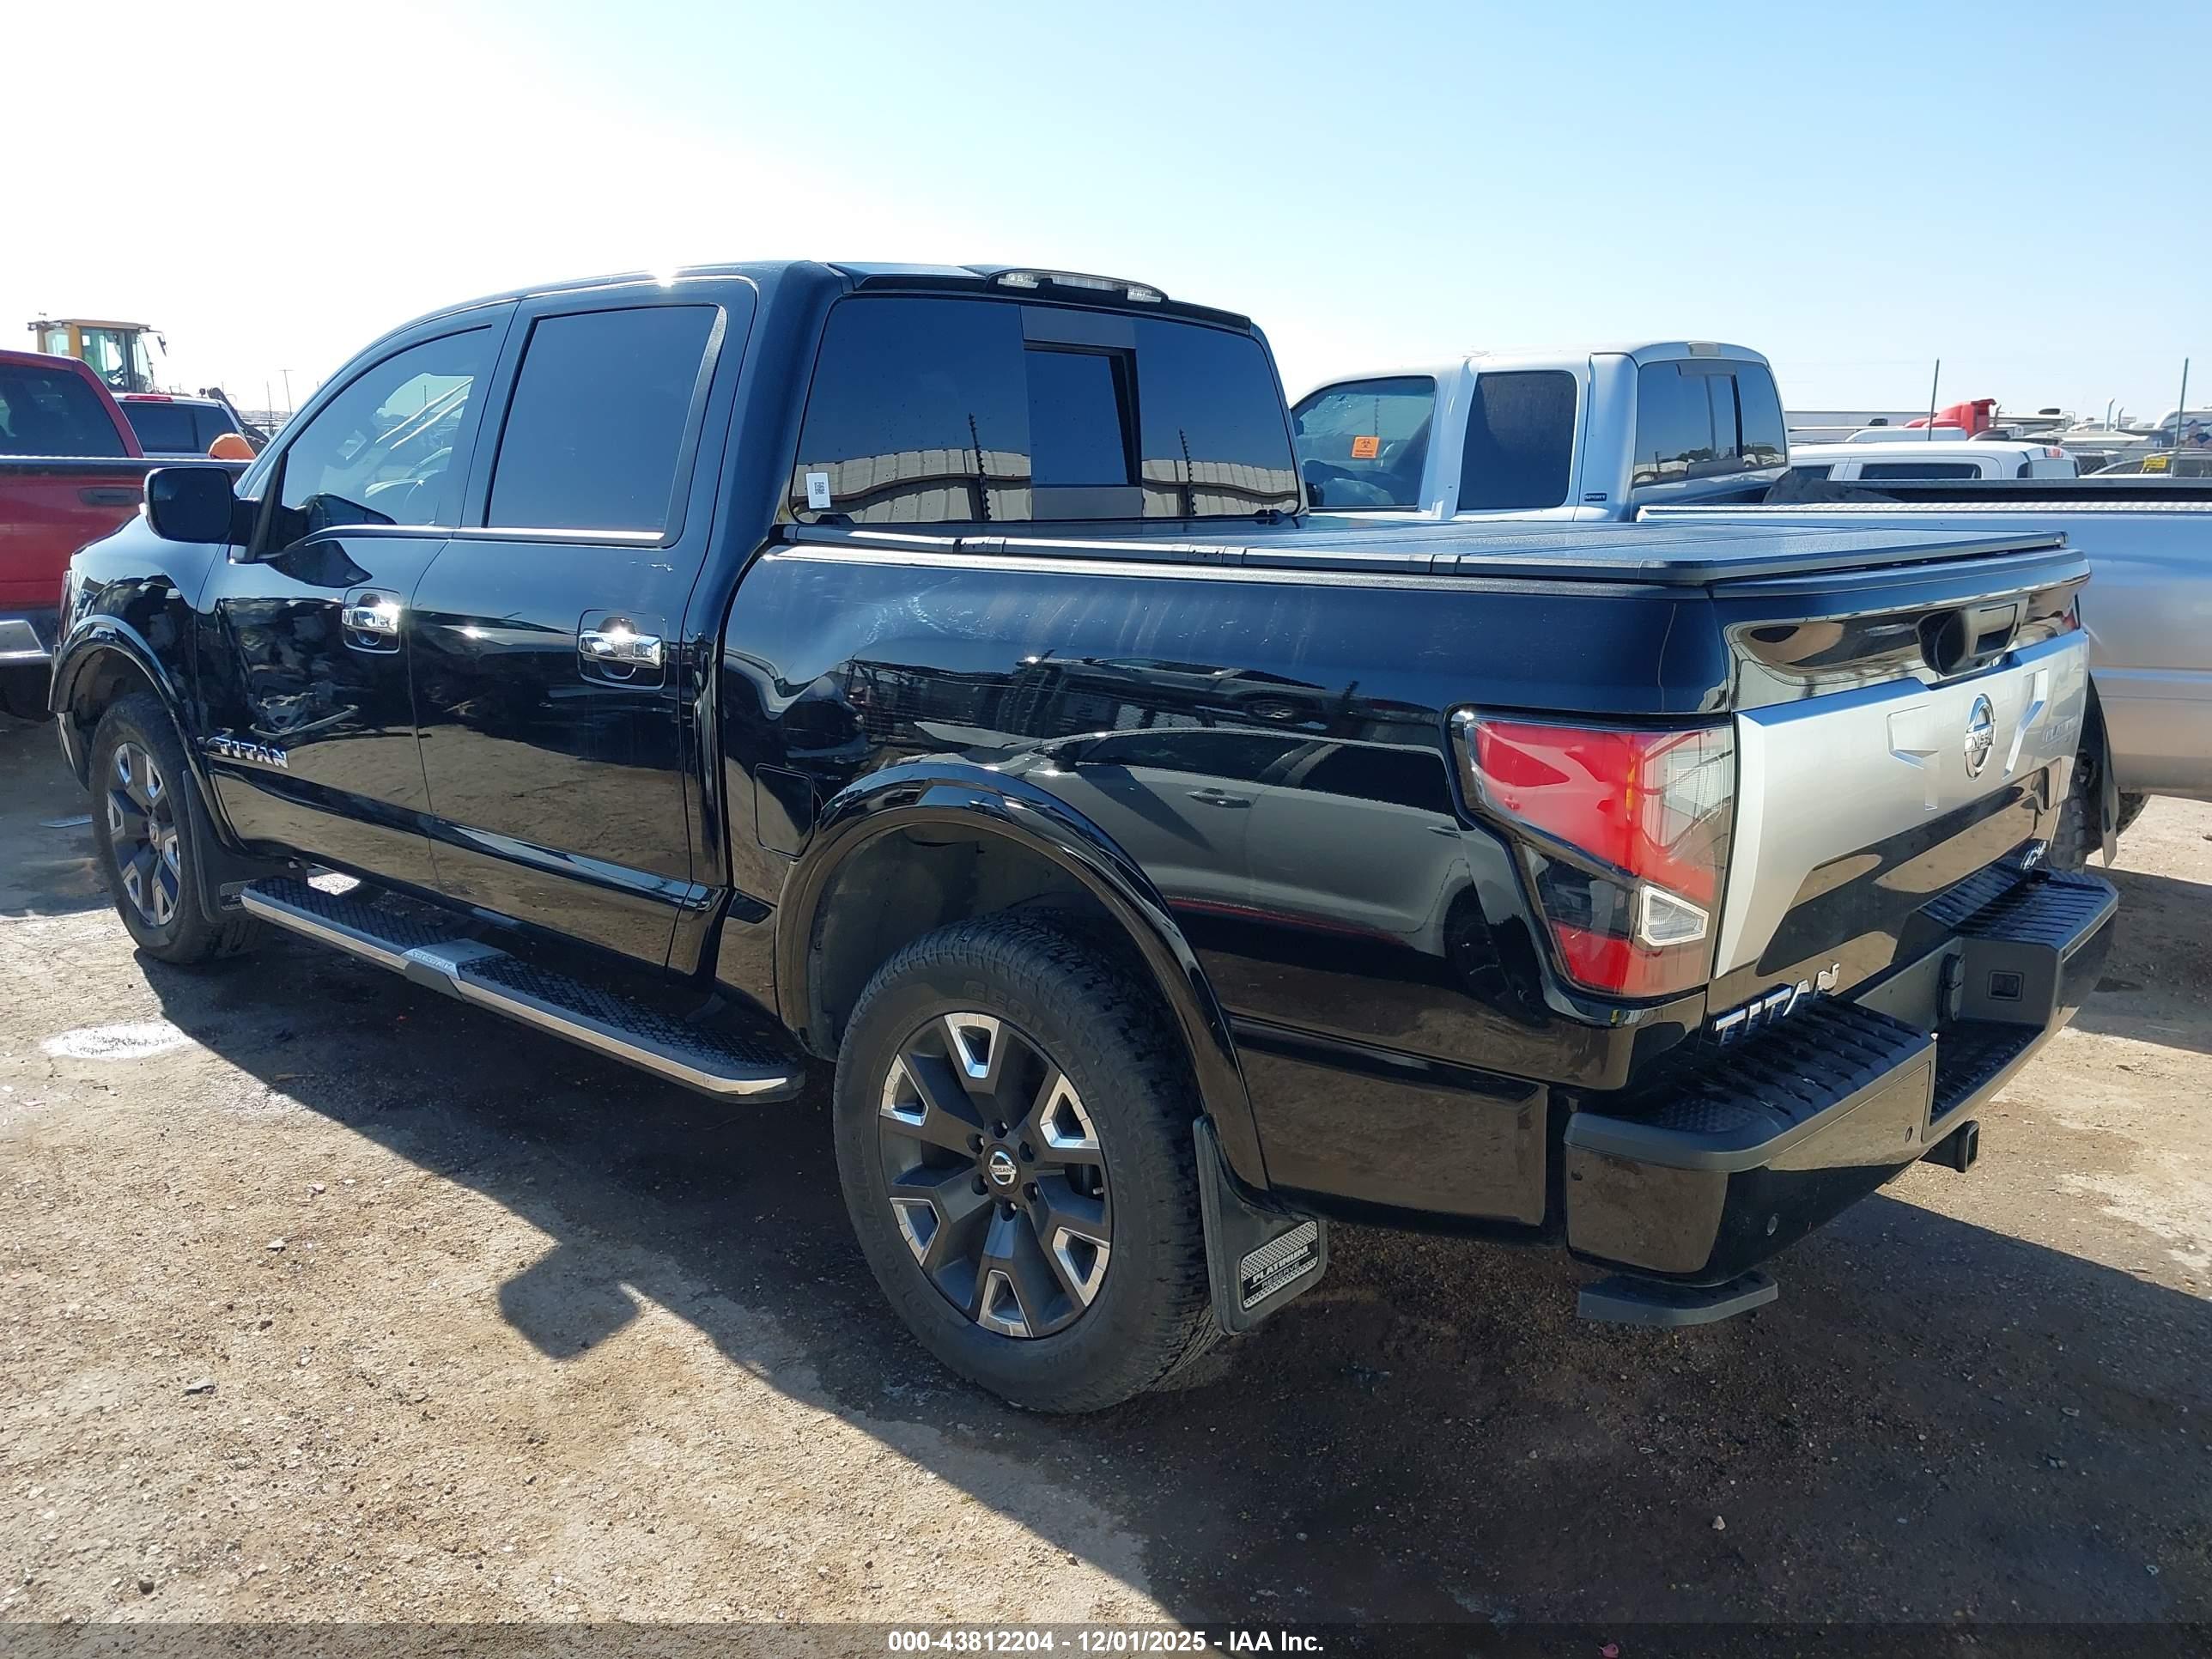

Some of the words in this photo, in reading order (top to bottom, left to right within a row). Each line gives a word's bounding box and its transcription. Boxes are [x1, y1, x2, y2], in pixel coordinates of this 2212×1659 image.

[1972, 727, 1992, 749] NISSA
[214, 738, 289, 769] TITAN
[1252, 1245, 1310, 1284] PLATINUM
[1261, 1261, 1301, 1289] RESERVE
